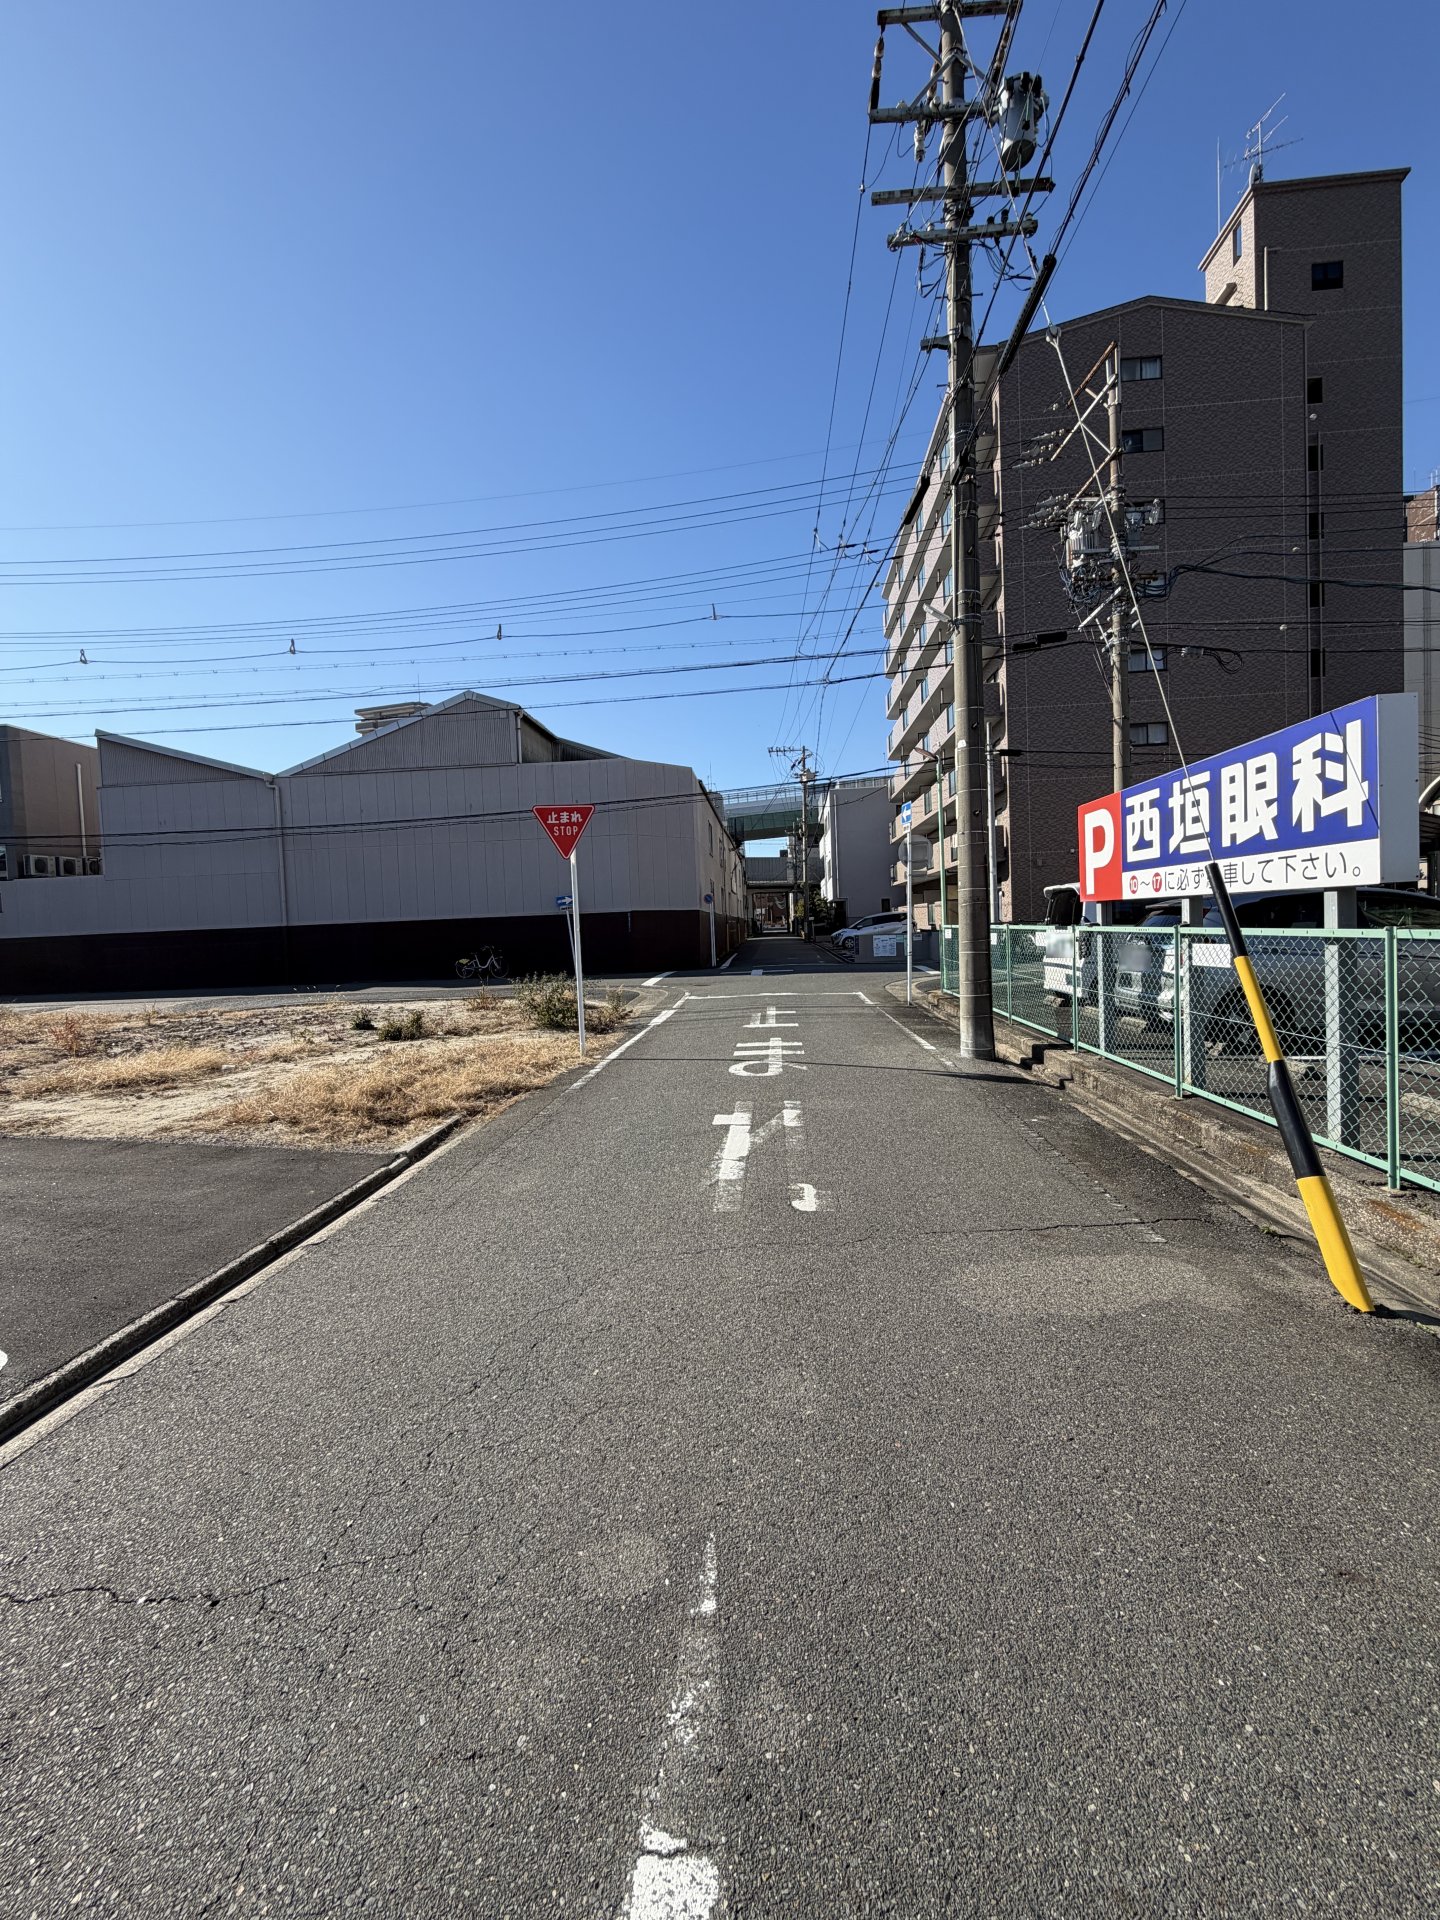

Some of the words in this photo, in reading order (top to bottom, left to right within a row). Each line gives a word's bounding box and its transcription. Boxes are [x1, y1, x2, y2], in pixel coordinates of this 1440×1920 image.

[1125, 719, 1369, 863] 西垣眼科
[547, 811, 583, 824] 止まれ
[553, 826, 578, 836] STOP
[1084, 808, 1115, 895] P
